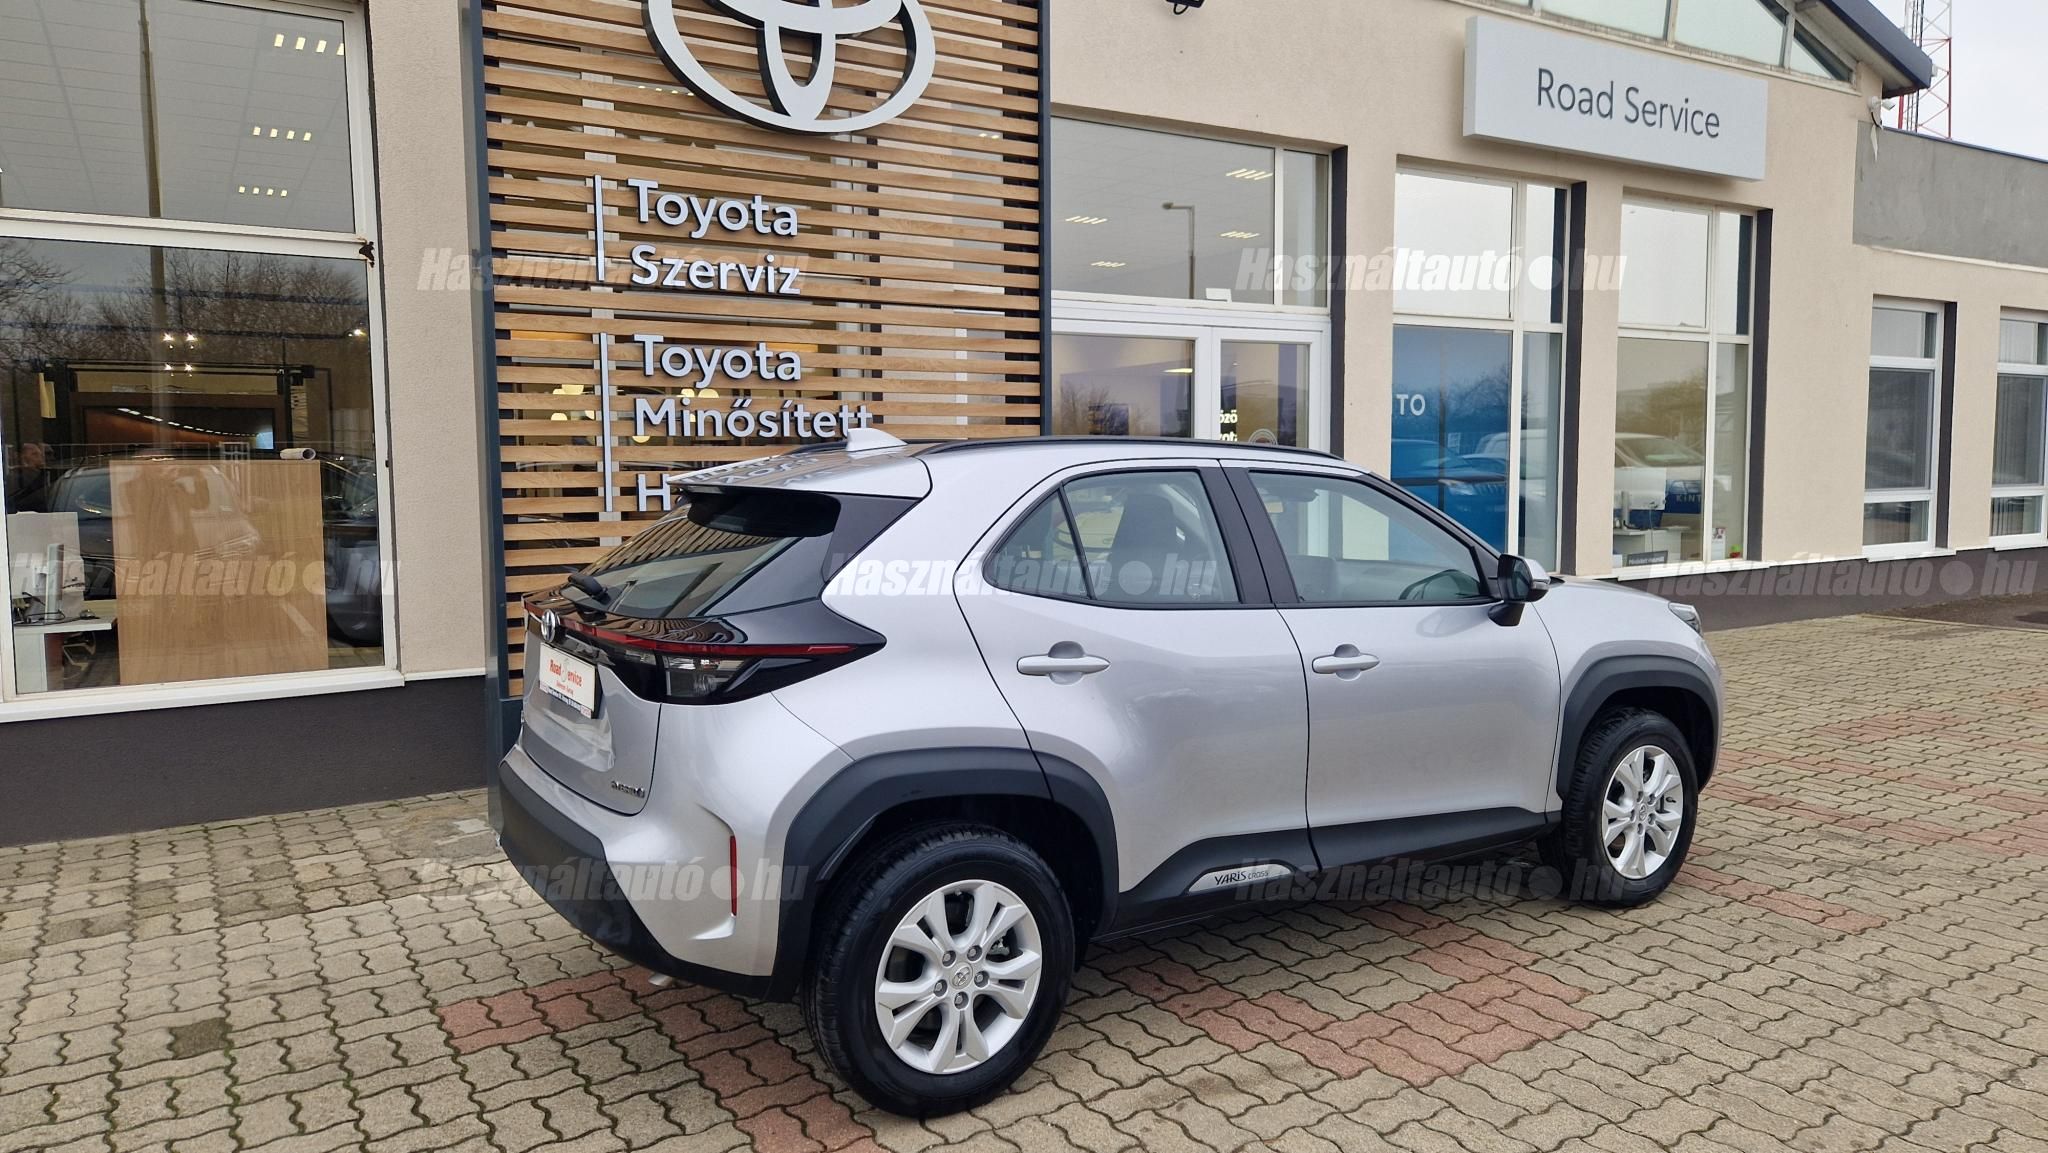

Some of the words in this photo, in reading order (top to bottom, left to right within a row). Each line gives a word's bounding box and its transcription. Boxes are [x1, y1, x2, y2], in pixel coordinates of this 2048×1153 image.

[1537, 67, 1614, 120] Road
[1624, 86, 1720, 139] Service
[627, 178, 799, 239] Toyota
[631, 244, 801, 295] Szerviz
[633, 333, 802, 389] Toyota
[635, 397, 873, 439] Minősített
[1396, 393, 1426, 416] TO
